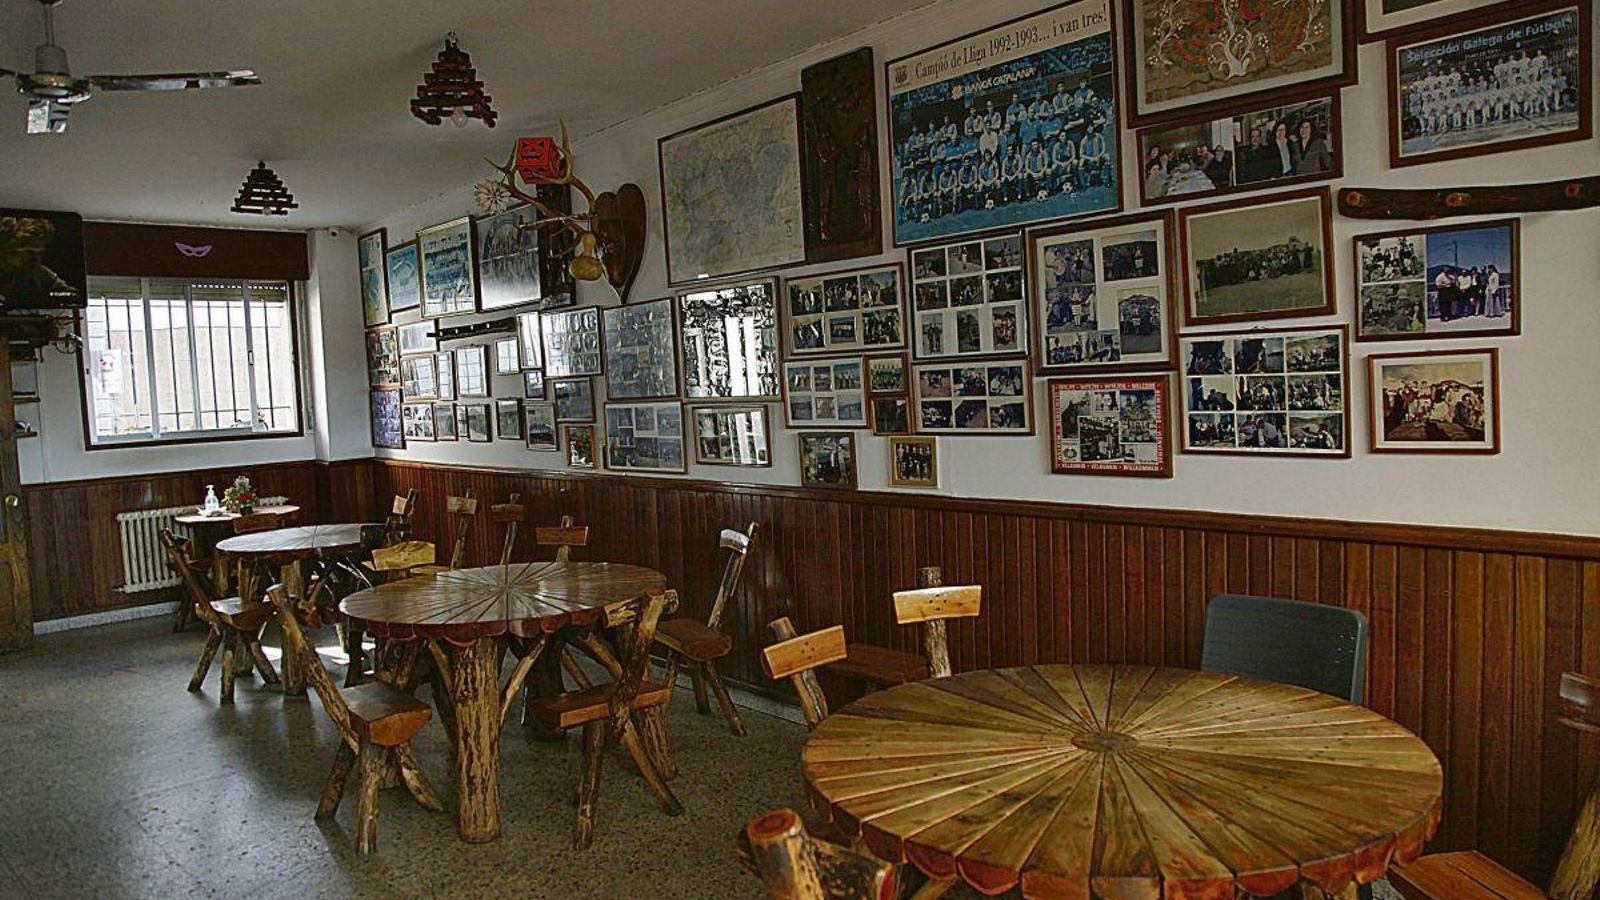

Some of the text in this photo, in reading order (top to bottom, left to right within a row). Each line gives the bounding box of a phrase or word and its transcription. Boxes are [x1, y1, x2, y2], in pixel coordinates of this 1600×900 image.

[915, 54, 949, 80] Campió
[950, 53, 962, 69] de
[963, 45, 987, 65] Lliga
[1052, 20, 1057, 37] i
[1059, 19, 1079, 34] van
[1082, 3, 1107, 27] tres!
[1506, 28, 1521, 40] de
[993, 67, 1034, 85] CATALANA
